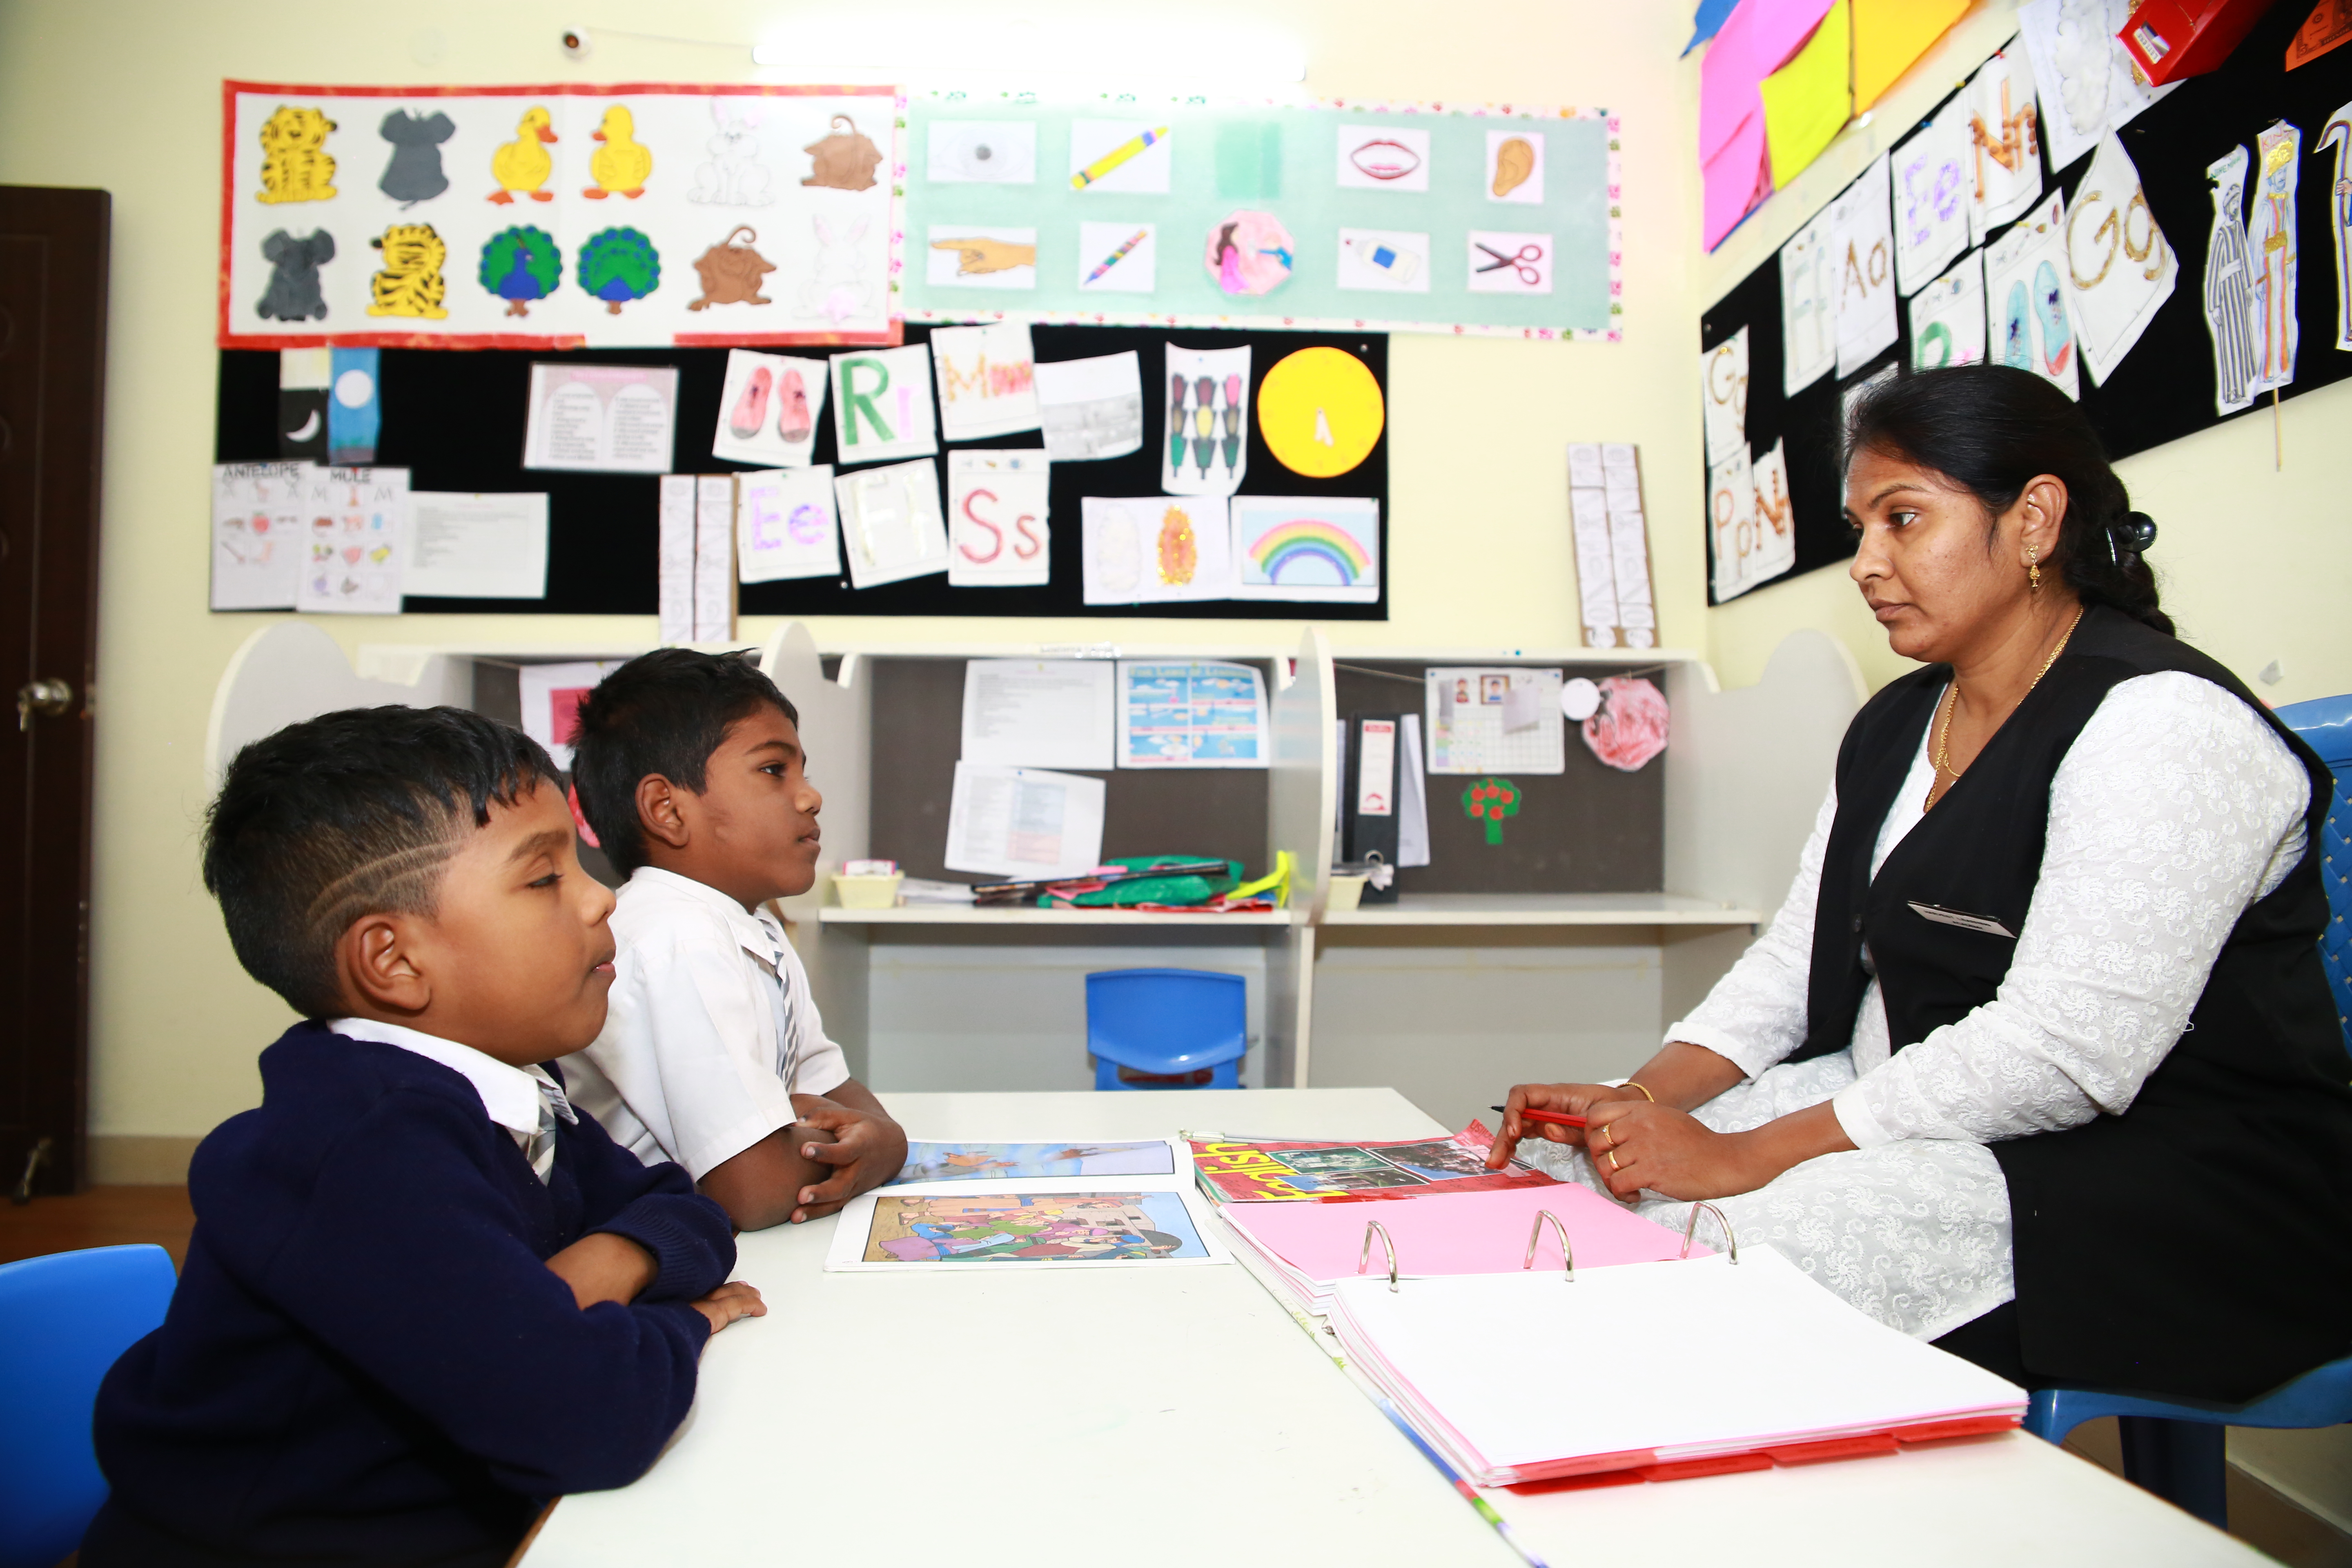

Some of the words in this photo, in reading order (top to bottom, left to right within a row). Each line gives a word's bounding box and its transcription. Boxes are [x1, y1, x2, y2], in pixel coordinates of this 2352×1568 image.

[1905, 154, 1960, 247] Ee
[840, 357, 922, 445] Rr
[330, 468, 371, 483] MULE
[750, 486, 829, 550] Ee
[1193, 1144, 1350, 1200] English
